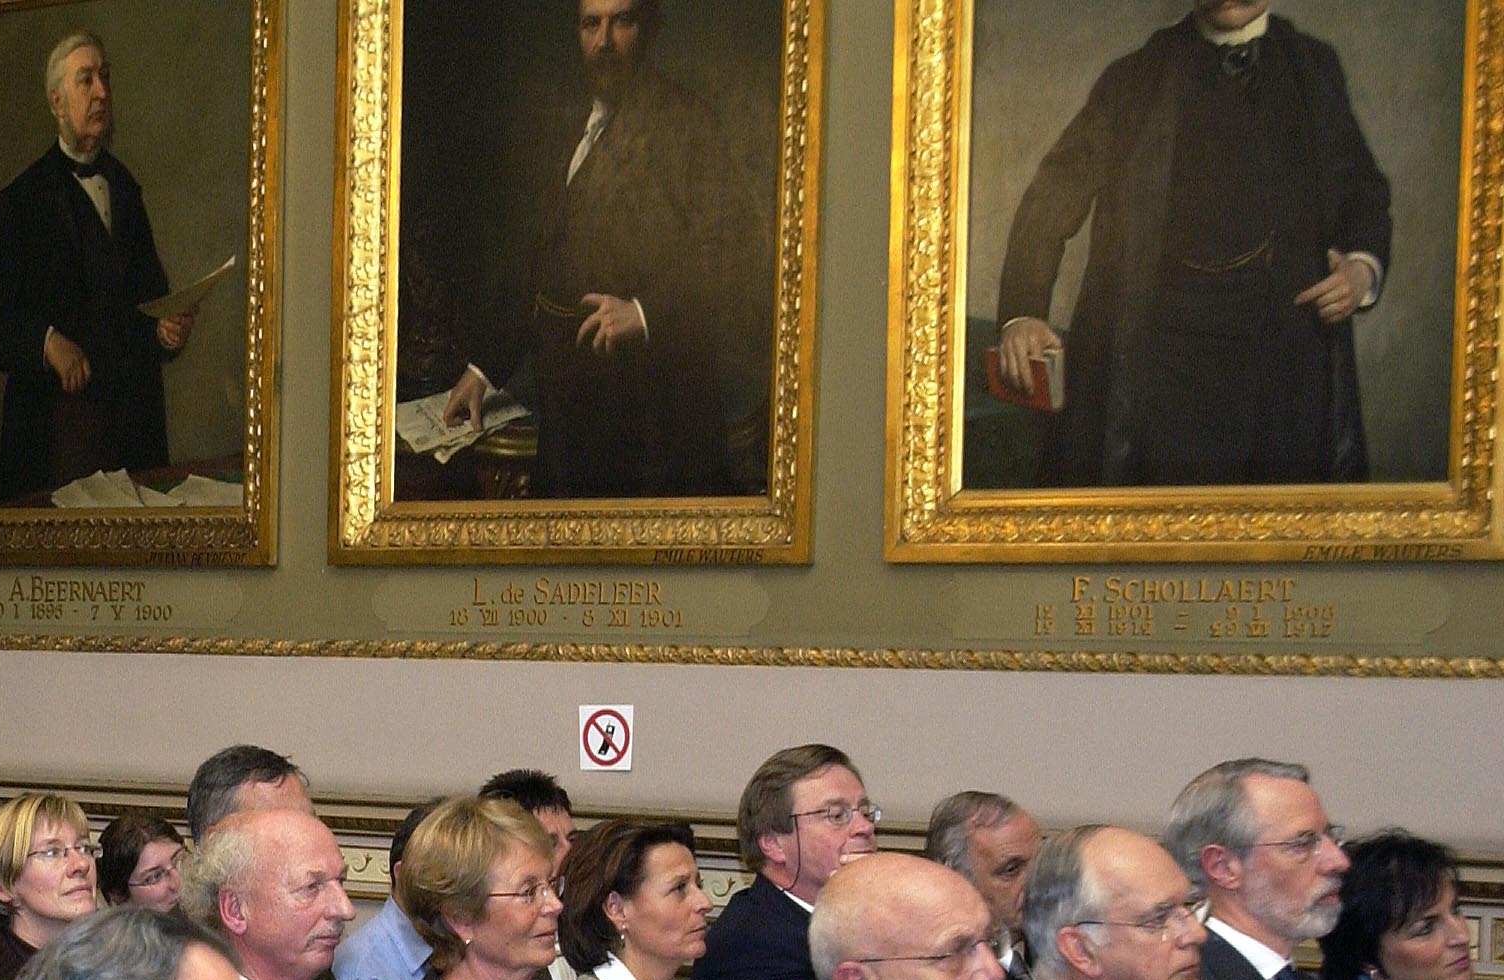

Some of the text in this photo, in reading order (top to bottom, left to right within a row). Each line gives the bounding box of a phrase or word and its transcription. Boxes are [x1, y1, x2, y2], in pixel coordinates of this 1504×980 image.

[1303, 545, 1364, 560] EMILE
[472, 577, 662, 606] L. de SADELEER
[1103, 576, 1296, 604] SCHOLLAERT
[90, 605, 100, 621] 7
[135, 605, 173, 622] 1900
[508, 608, 548, 627] 1900
[641, 609, 684, 628] 1901
